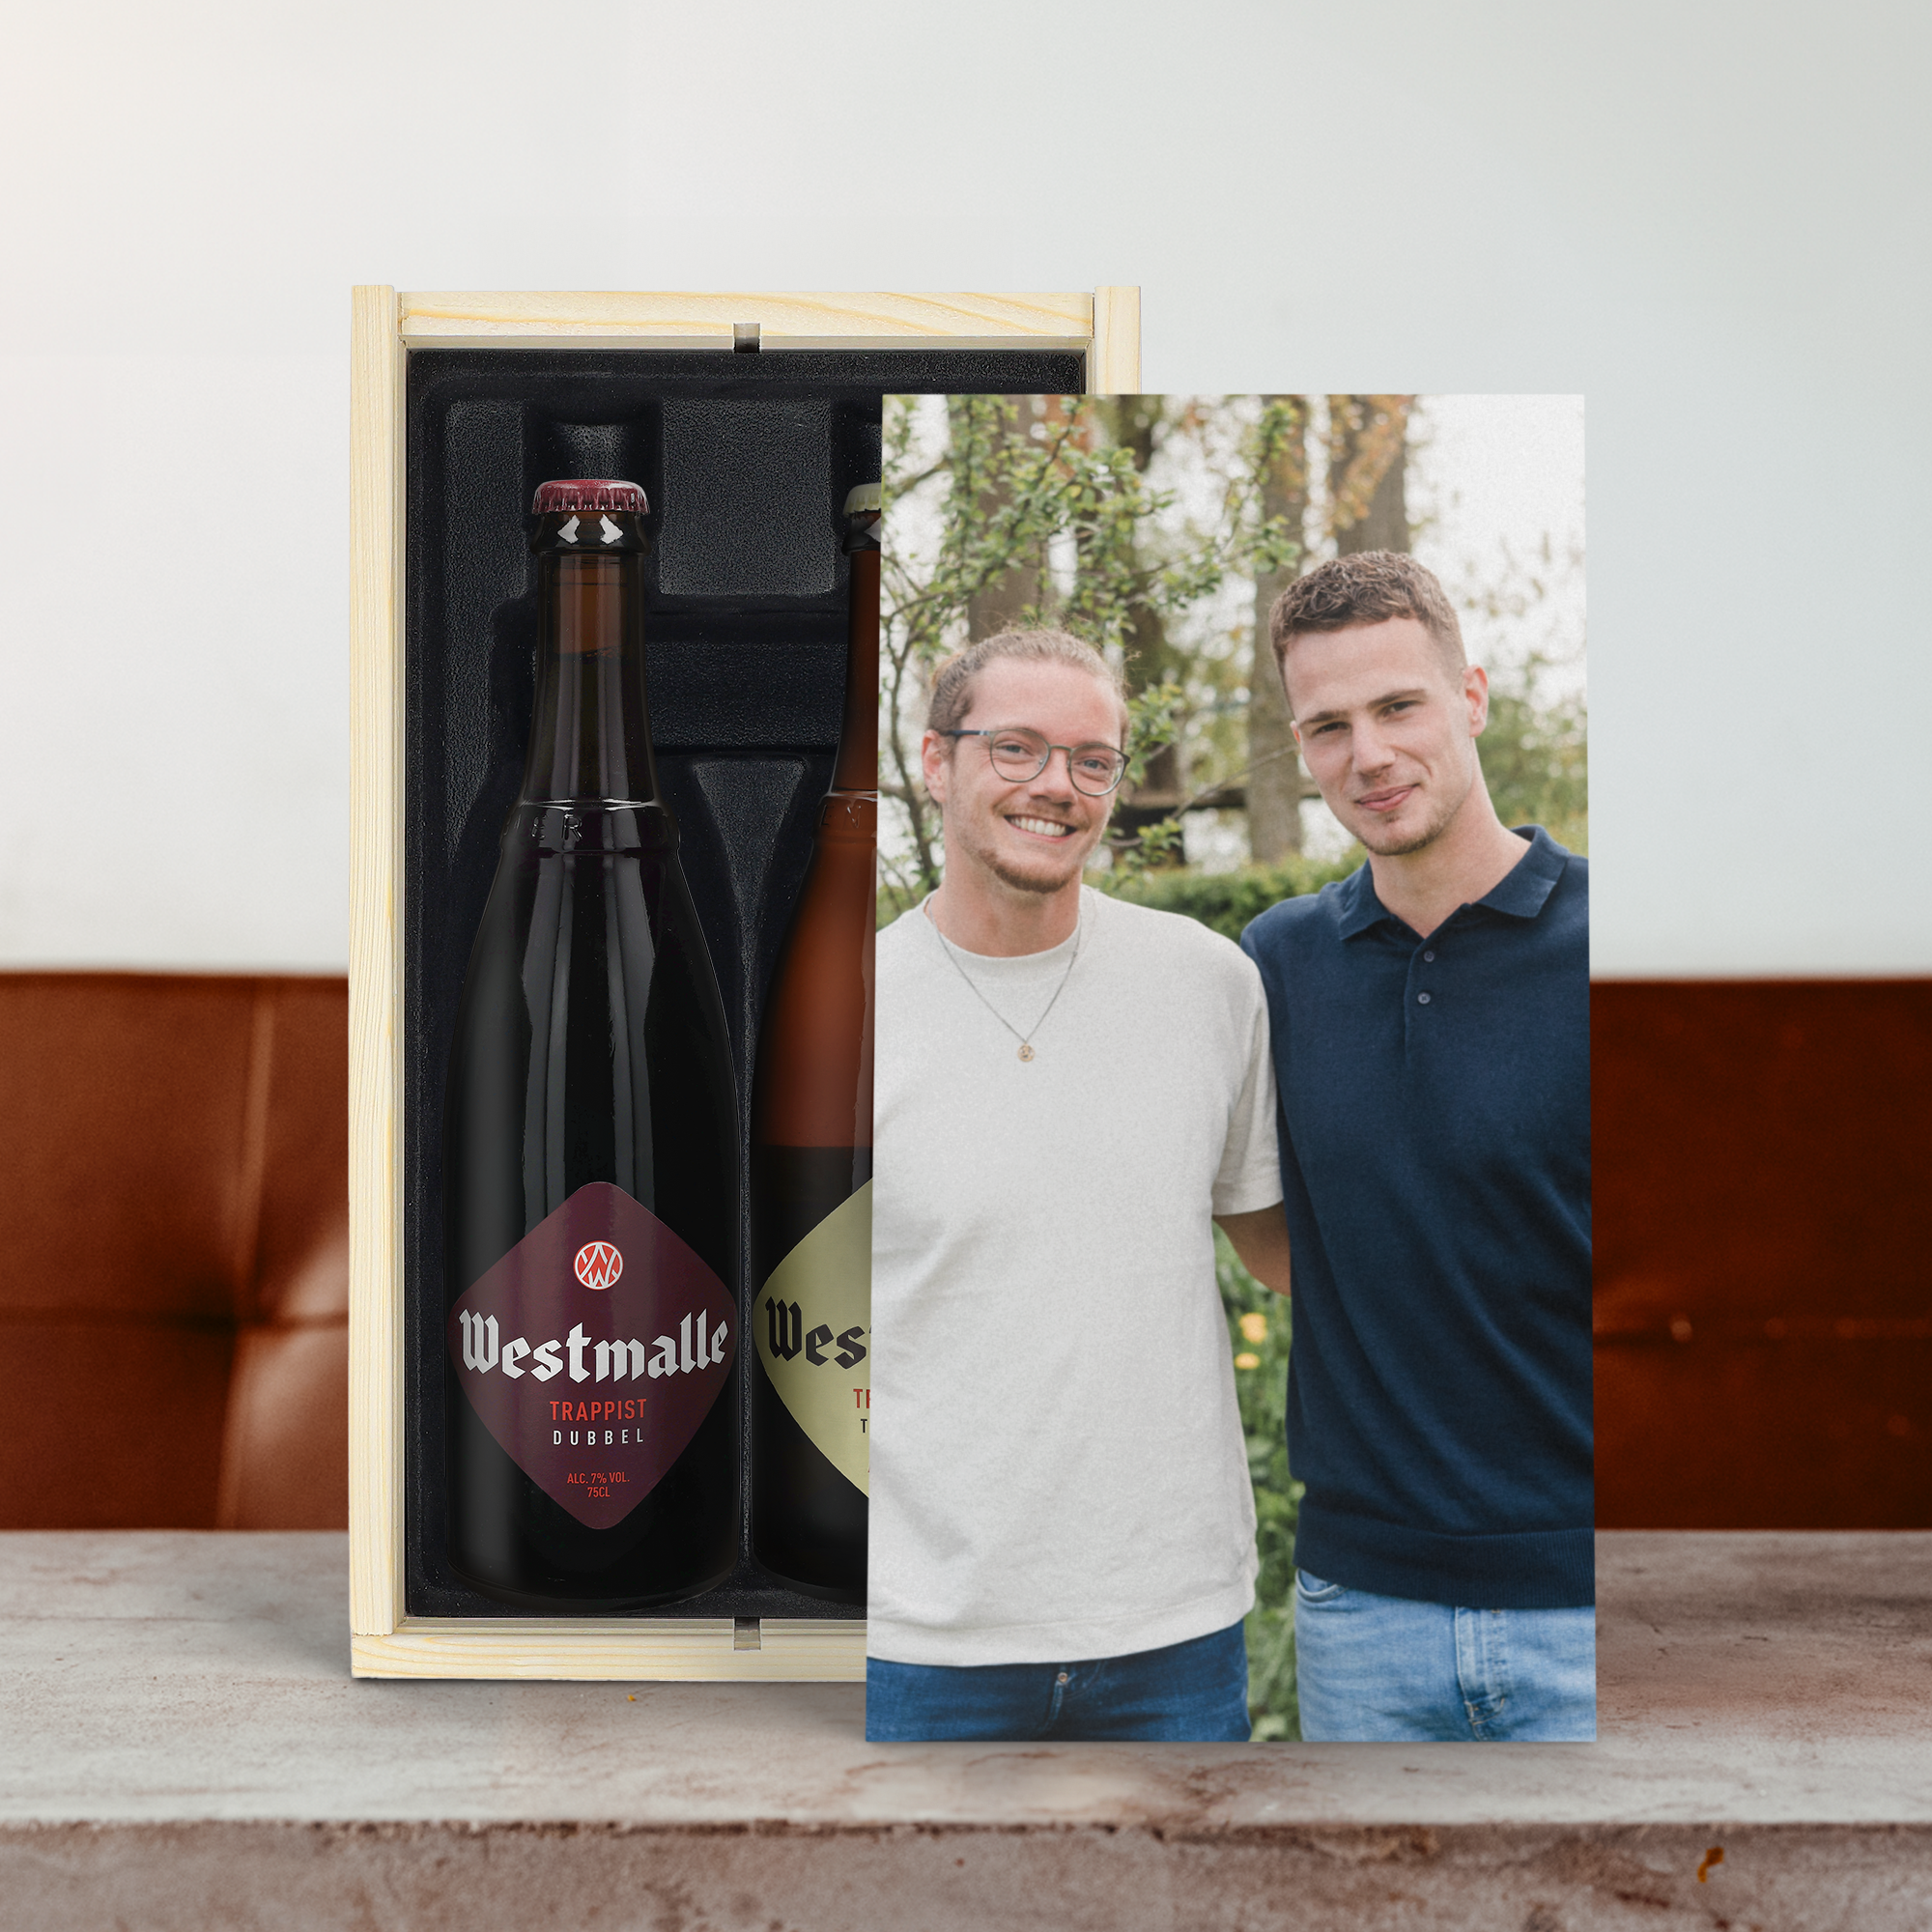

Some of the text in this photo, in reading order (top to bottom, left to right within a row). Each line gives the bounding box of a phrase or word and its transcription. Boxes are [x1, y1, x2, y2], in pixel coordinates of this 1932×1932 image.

[458, 1308, 728, 1383] Westmalle
[549, 1398, 647, 1421] TRAPPIST
[553, 1428, 643, 1446] DUBBEL
[566, 1471, 631, 1485] ALC. 7% VOL.
[586, 1486, 611, 1498] 75CL
